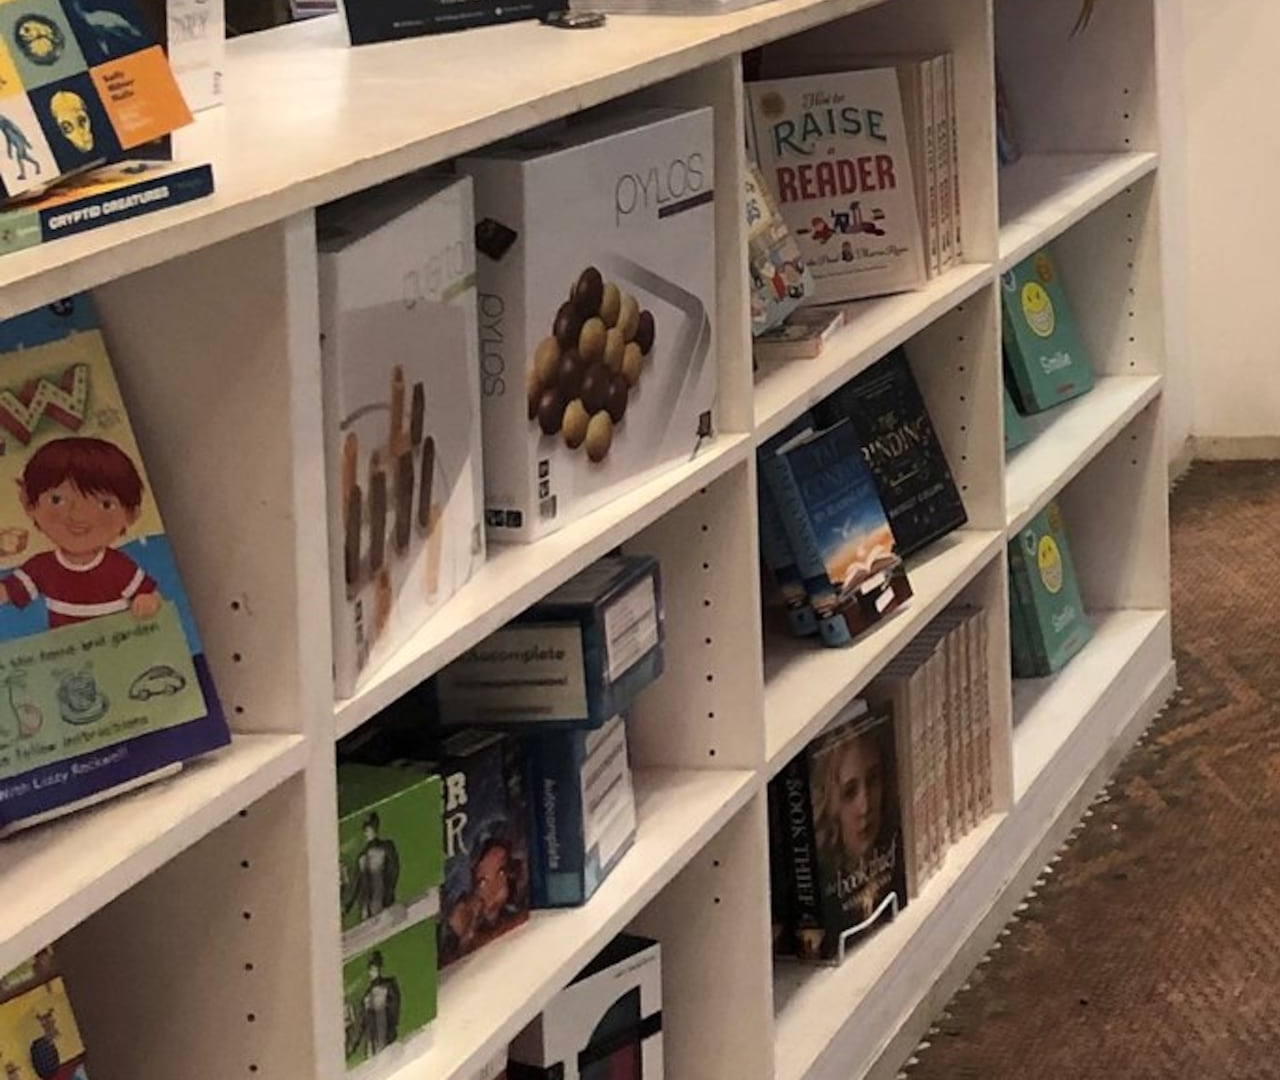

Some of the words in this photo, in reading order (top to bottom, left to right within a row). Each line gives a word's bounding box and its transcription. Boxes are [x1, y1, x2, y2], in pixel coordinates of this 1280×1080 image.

[773, 106, 887, 157] RAISE
[776, 153, 897, 203] READER
[48, 204, 103, 230] CRYPTID
[102, 186, 170, 216] CREATURES
[479, 292, 505, 397] PYLOS
[786, 778, 806, 839] BOOK
